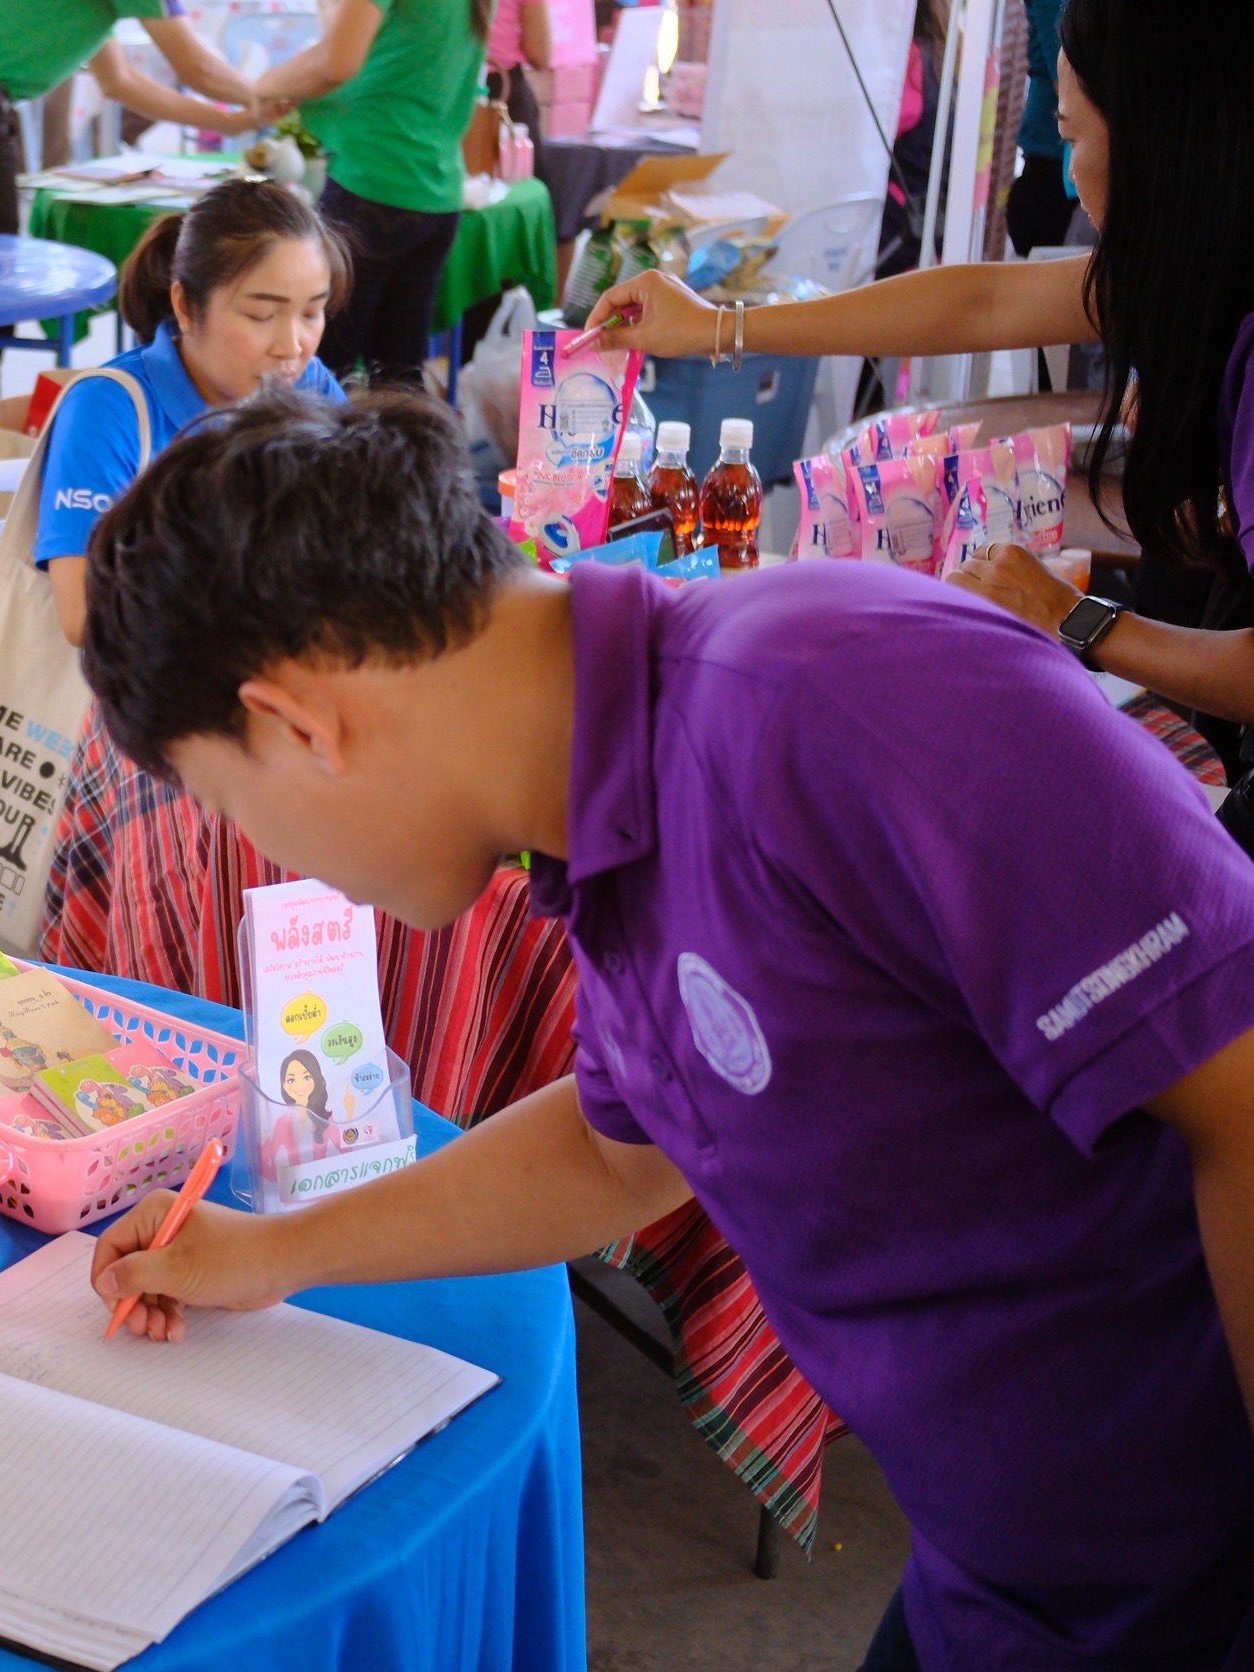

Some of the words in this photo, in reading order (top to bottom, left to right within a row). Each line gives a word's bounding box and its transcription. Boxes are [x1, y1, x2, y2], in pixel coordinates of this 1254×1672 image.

[271, 906, 353, 951] พลังสตรี
[1036, 911, 1189, 1041] SAMUTSONGKHRAM
